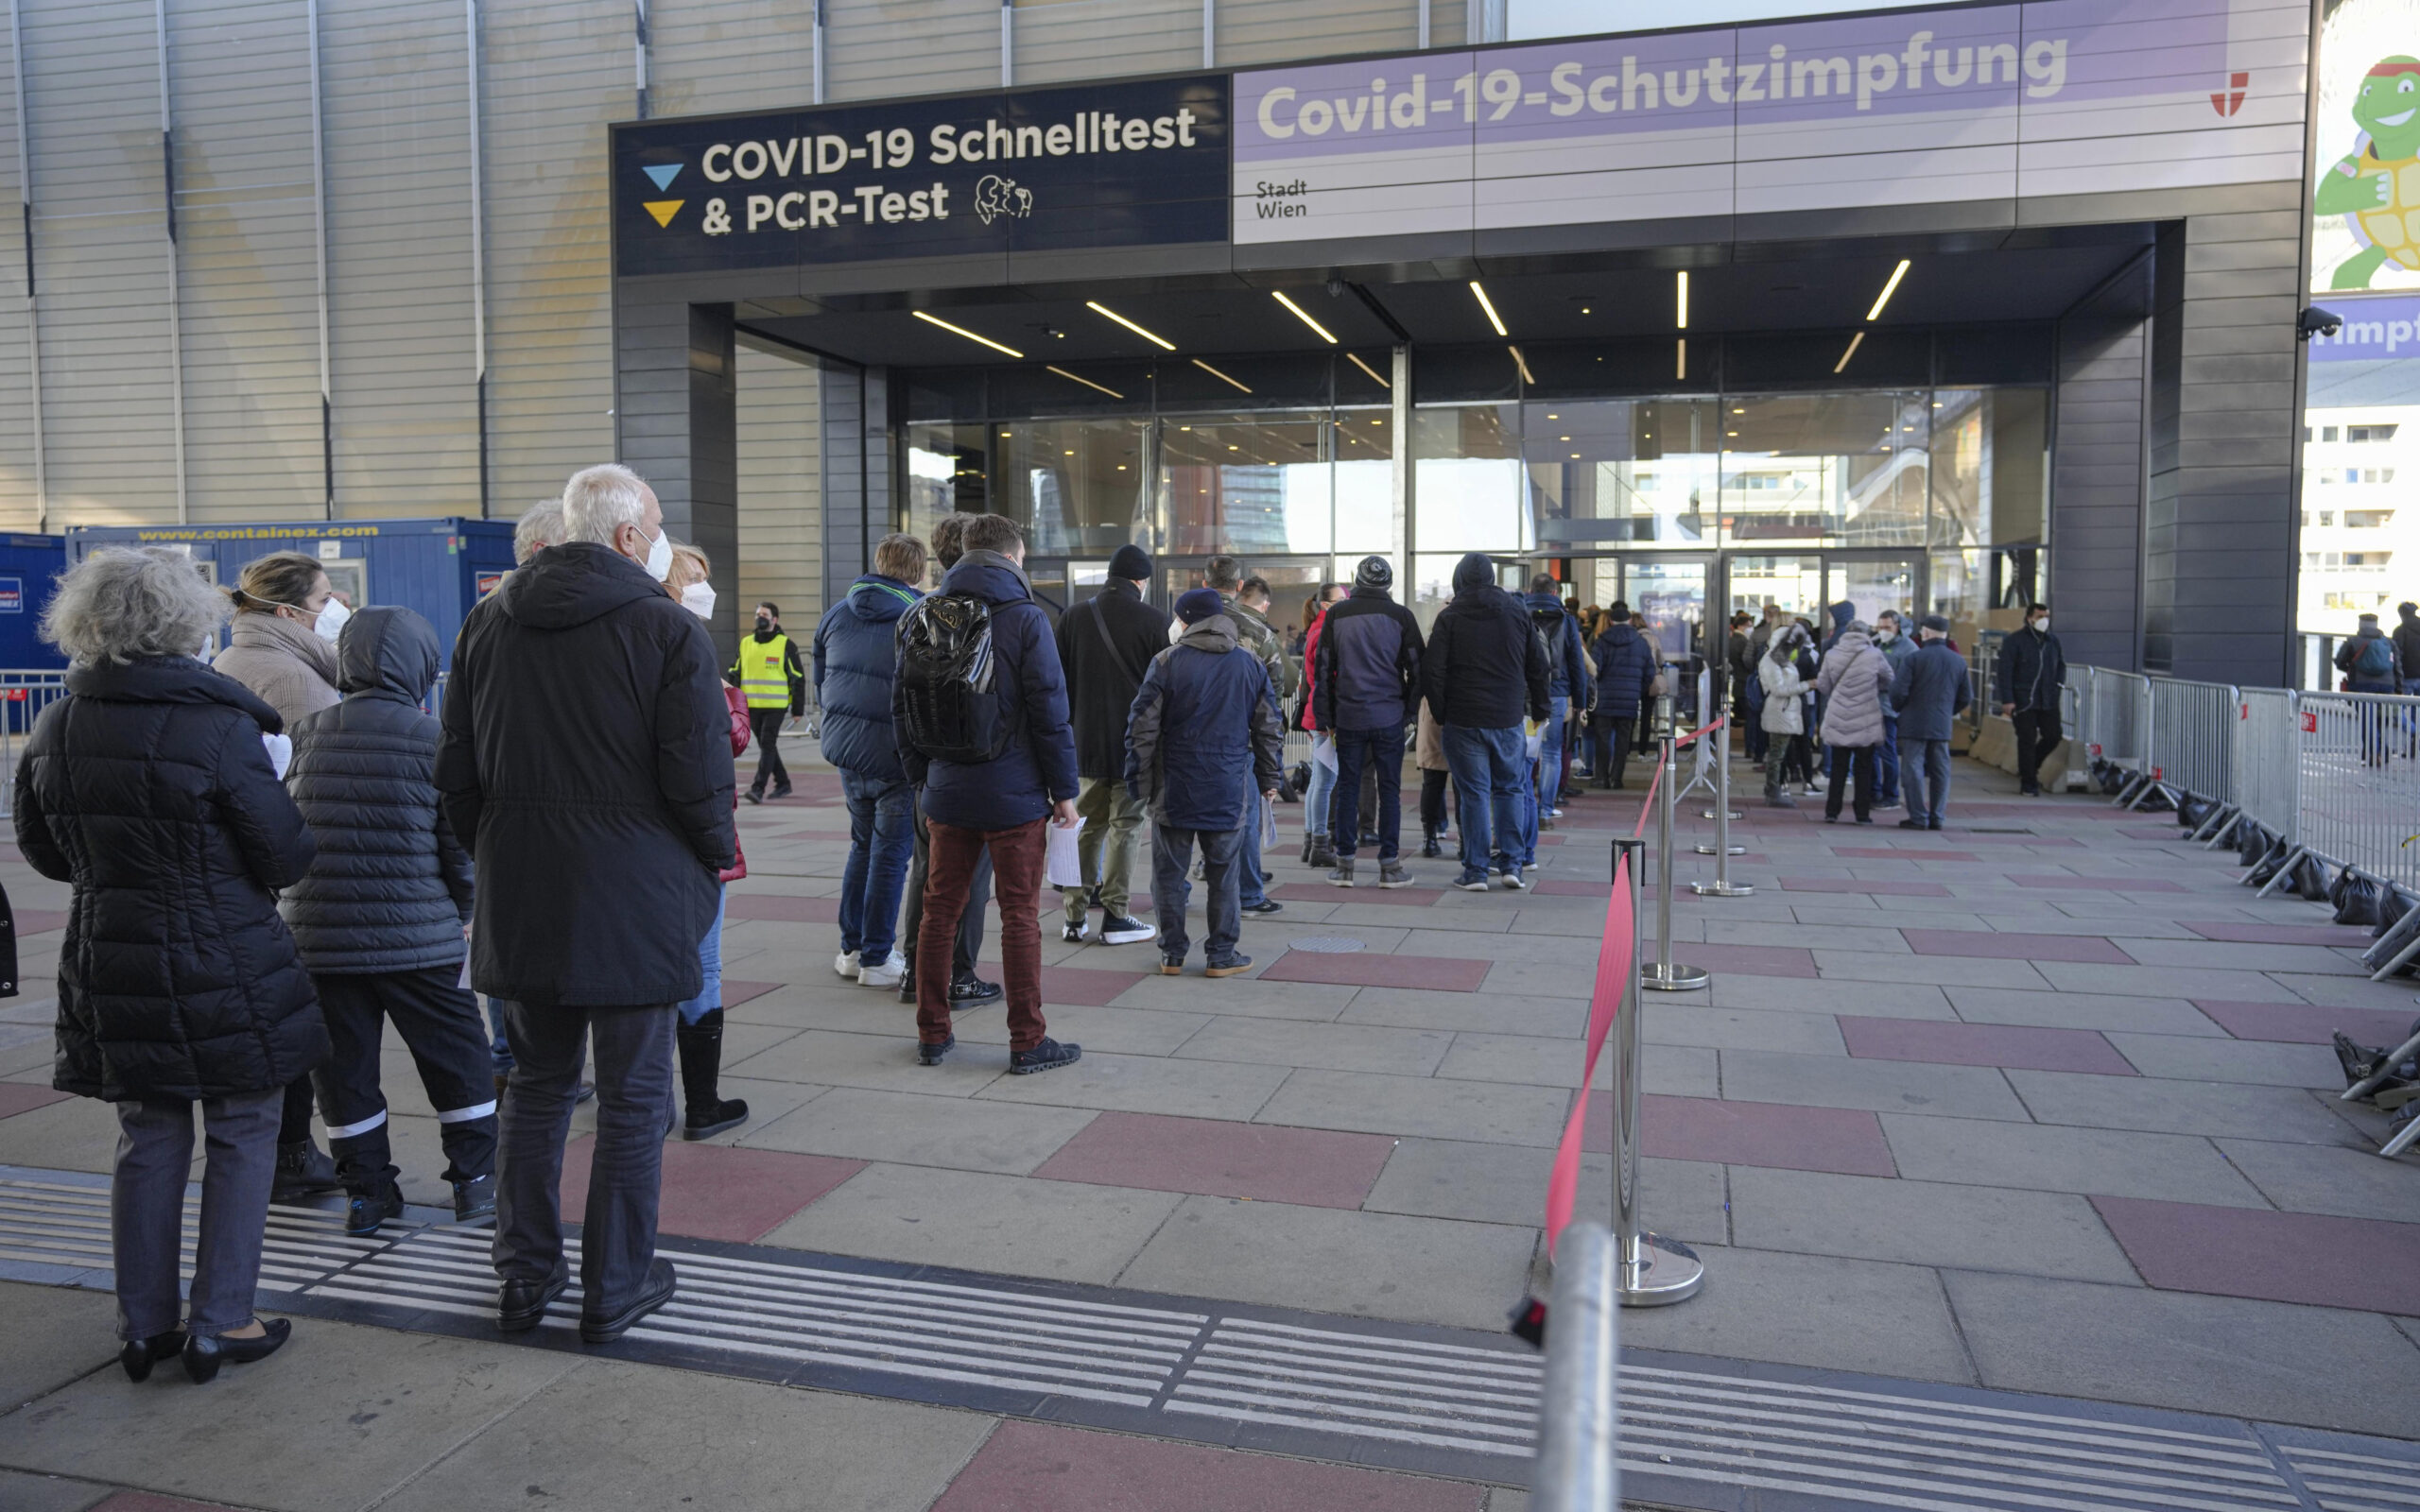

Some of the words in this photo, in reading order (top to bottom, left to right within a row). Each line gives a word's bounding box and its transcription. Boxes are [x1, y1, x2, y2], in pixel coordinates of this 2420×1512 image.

[1256, 30, 2068, 140] Covid-19-Schutzimpfung
[701, 128, 915, 183] COVID-19
[929, 108, 1196, 164] Schnelltest
[1255, 179, 1307, 198] Stadt
[701, 198, 733, 236] &
[747, 181, 949, 232] PCR-Test
[1255, 201, 1307, 219] Wien
[138, 525, 379, 541] www.containex.com
